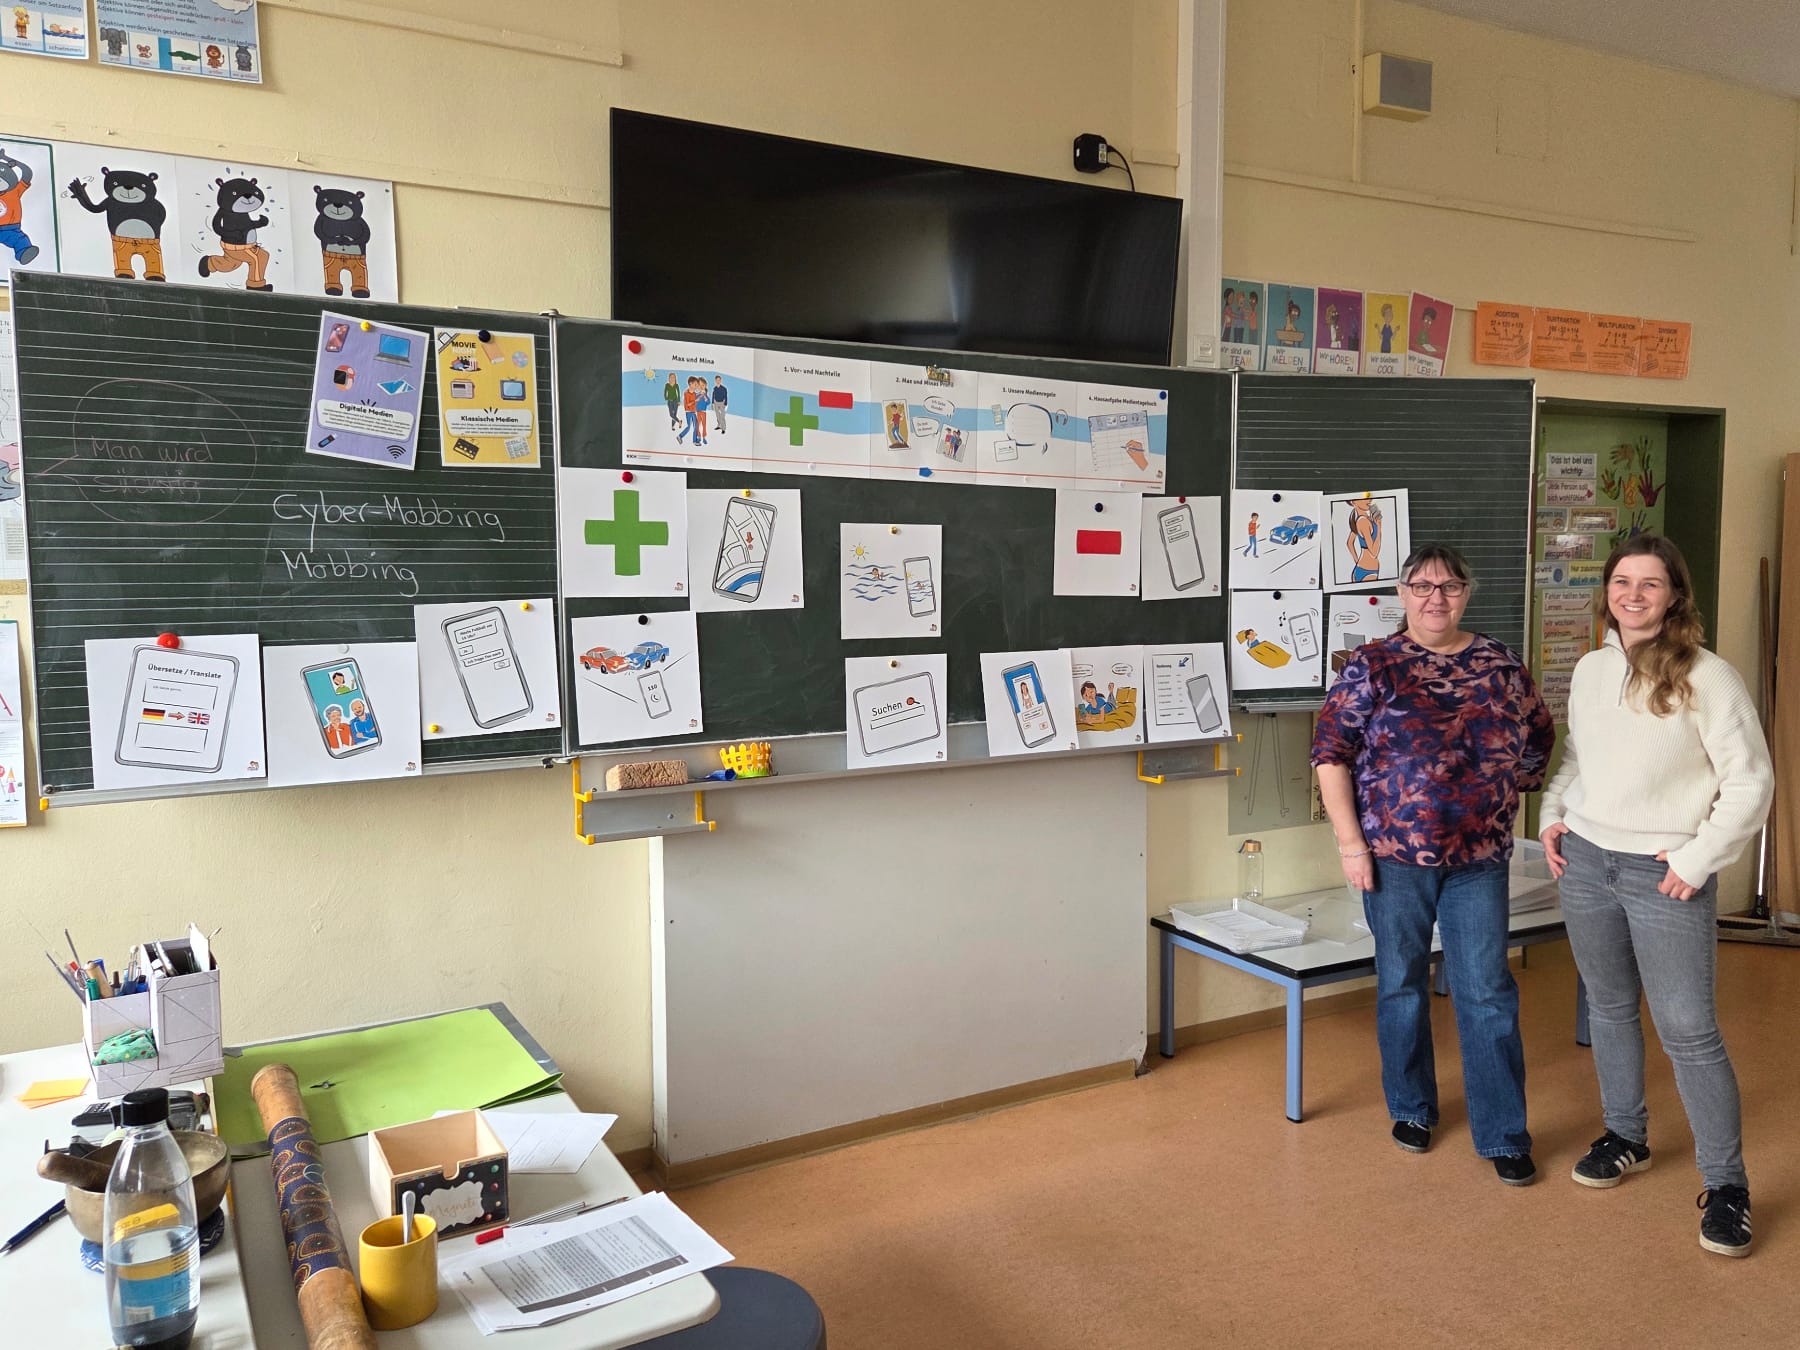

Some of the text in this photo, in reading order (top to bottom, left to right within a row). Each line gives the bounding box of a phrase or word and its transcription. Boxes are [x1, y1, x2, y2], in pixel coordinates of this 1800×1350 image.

[672, 354, 685, 362] Max
[699, 357, 715, 365] Mina
[814, 369, 841, 377] Nachteile
[923, 379, 939, 387] Minas
[1025, 389, 1057, 398] Medienregeln
[1094, 396, 1122, 404] Hausaufgabe
[1122, 398, 1157, 406] Medientagebuch
[339, 403, 394, 418] Digitale Medien
[91, 432, 213, 462] Man wird
[1551, 456, 1593, 465] Das ist bei uns
[273, 490, 506, 553] Cyber-Mobbing
[280, 549, 420, 598] Mobbing
[148, 663, 183, 674] Übersetze
[189, 669, 222, 679] Translate
[871, 702, 903, 716] Suchen
